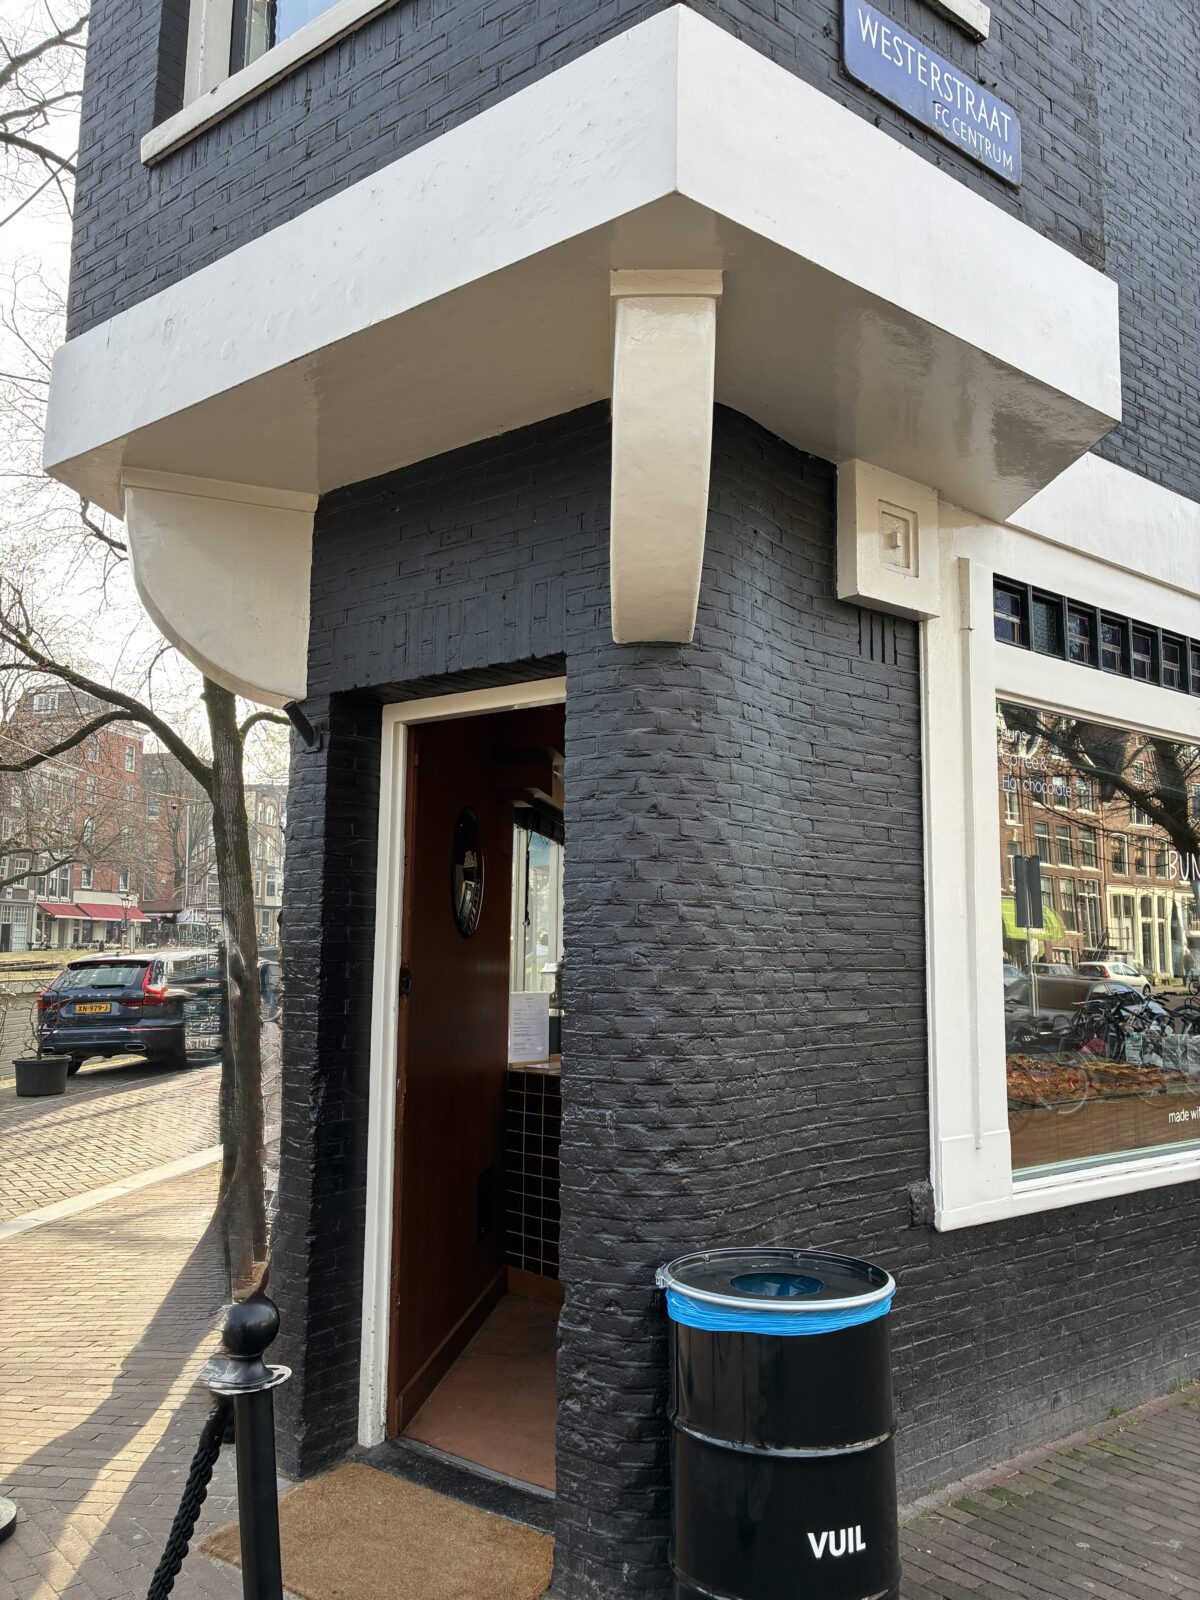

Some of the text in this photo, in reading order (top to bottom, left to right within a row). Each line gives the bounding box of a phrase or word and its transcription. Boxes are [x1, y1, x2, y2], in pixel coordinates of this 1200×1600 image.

[857, 8, 1012, 143] WESTERSTRAAT
[935, 103, 1014, 172] FC CENTRUM
[1002, 774, 1073, 797] Hot chocolate
[1168, 1108, 1190, 1124] made
[807, 1525, 867, 1559] VUIL
